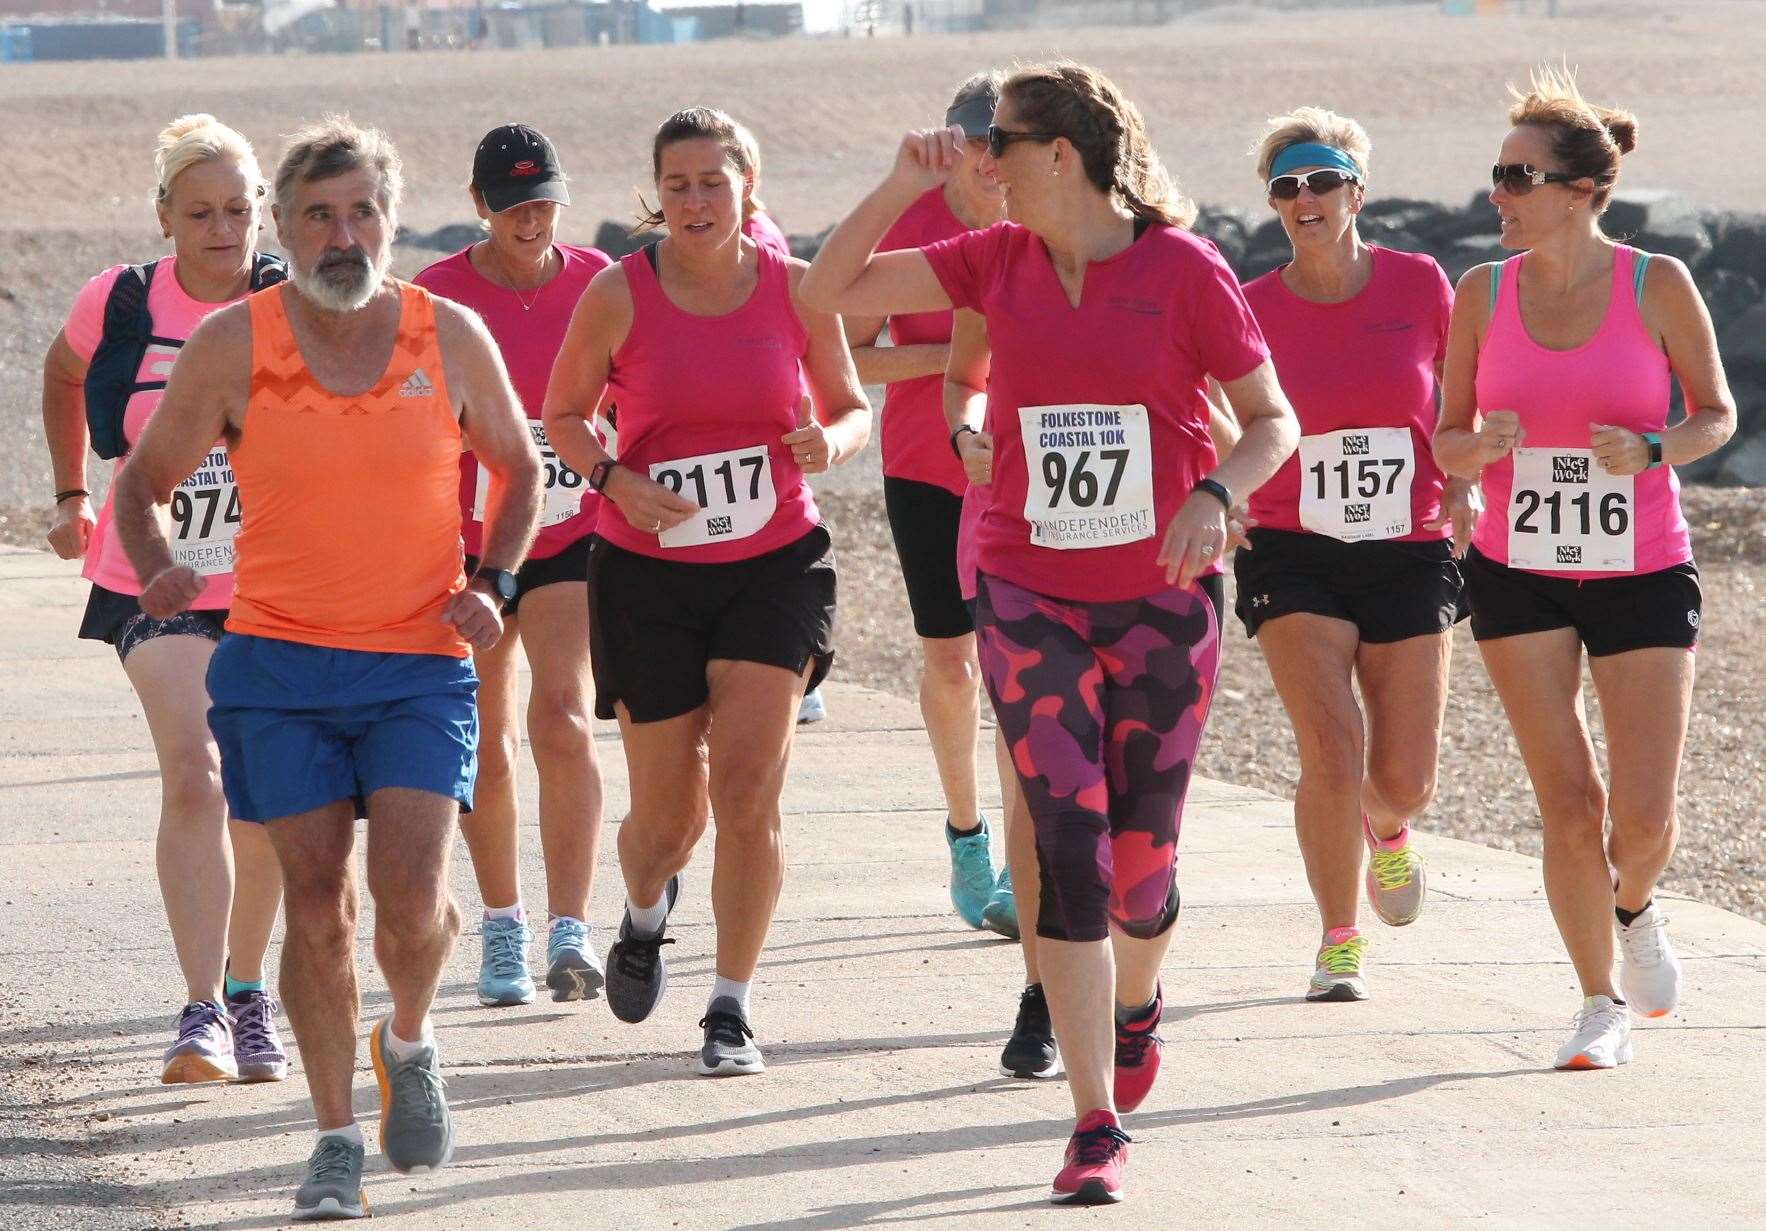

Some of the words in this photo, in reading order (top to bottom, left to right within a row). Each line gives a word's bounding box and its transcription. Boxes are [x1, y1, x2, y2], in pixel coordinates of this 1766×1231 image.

[1041, 411, 1121, 428] FOLKESTONE
[1040, 432, 1096, 447] COASTAL
[1099, 430, 1125, 445] 10K
[1556, 454, 1586, 469] Nice
[1042, 449, 1130, 508] 967
[1310, 459, 1405, 499] 1157
[1554, 467, 1588, 483] Work
[171, 486, 242, 540] 974
[1043, 508, 1149, 532] INDEPENDENT
[1515, 489, 1629, 536] 2116
[1048, 529, 1098, 542] INSURANCE
[1102, 523, 1149, 538] SERVICES
[1386, 524, 1405, 535] 1157
[175, 545, 232, 562] INDEPEN
